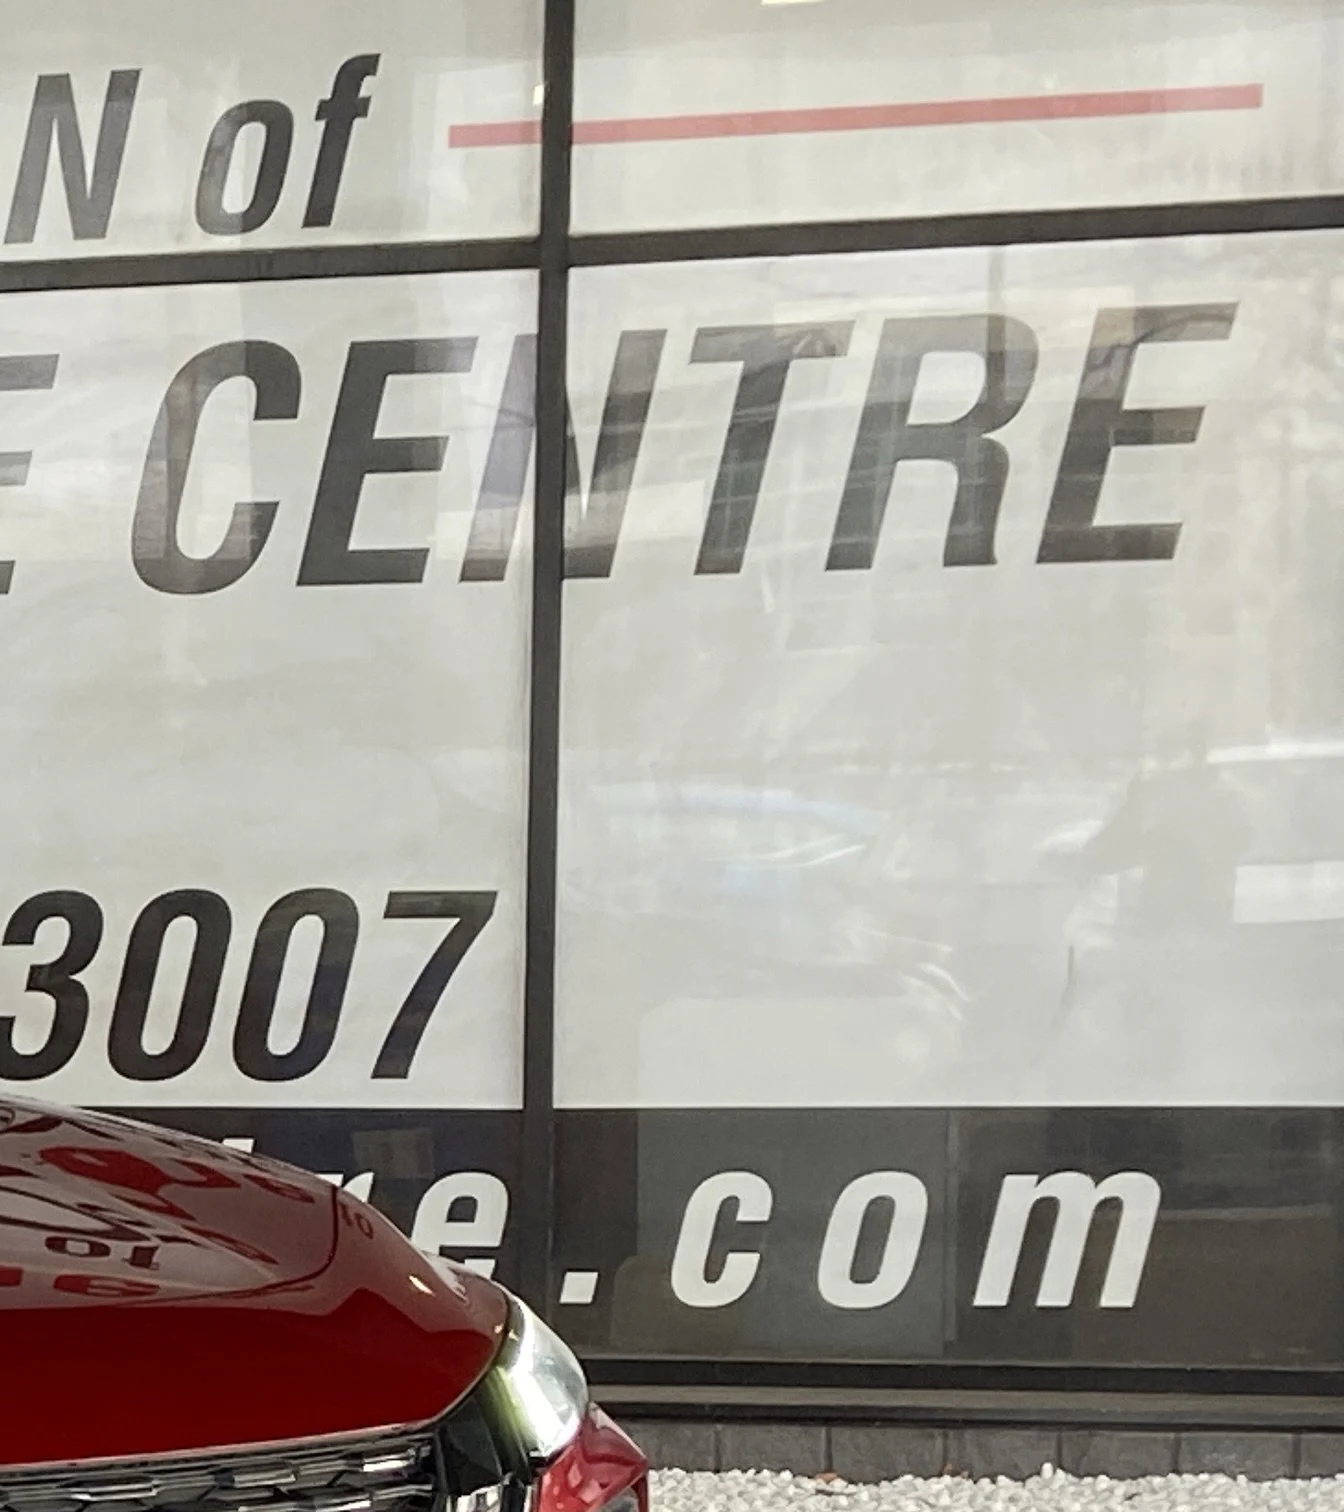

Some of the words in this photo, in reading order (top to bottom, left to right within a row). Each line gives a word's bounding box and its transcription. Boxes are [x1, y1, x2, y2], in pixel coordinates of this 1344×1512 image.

[194, 53, 381, 237] of
[131, 301, 1240, 595] CENTRE
[314, 1168, 1162, 1309] e.com
